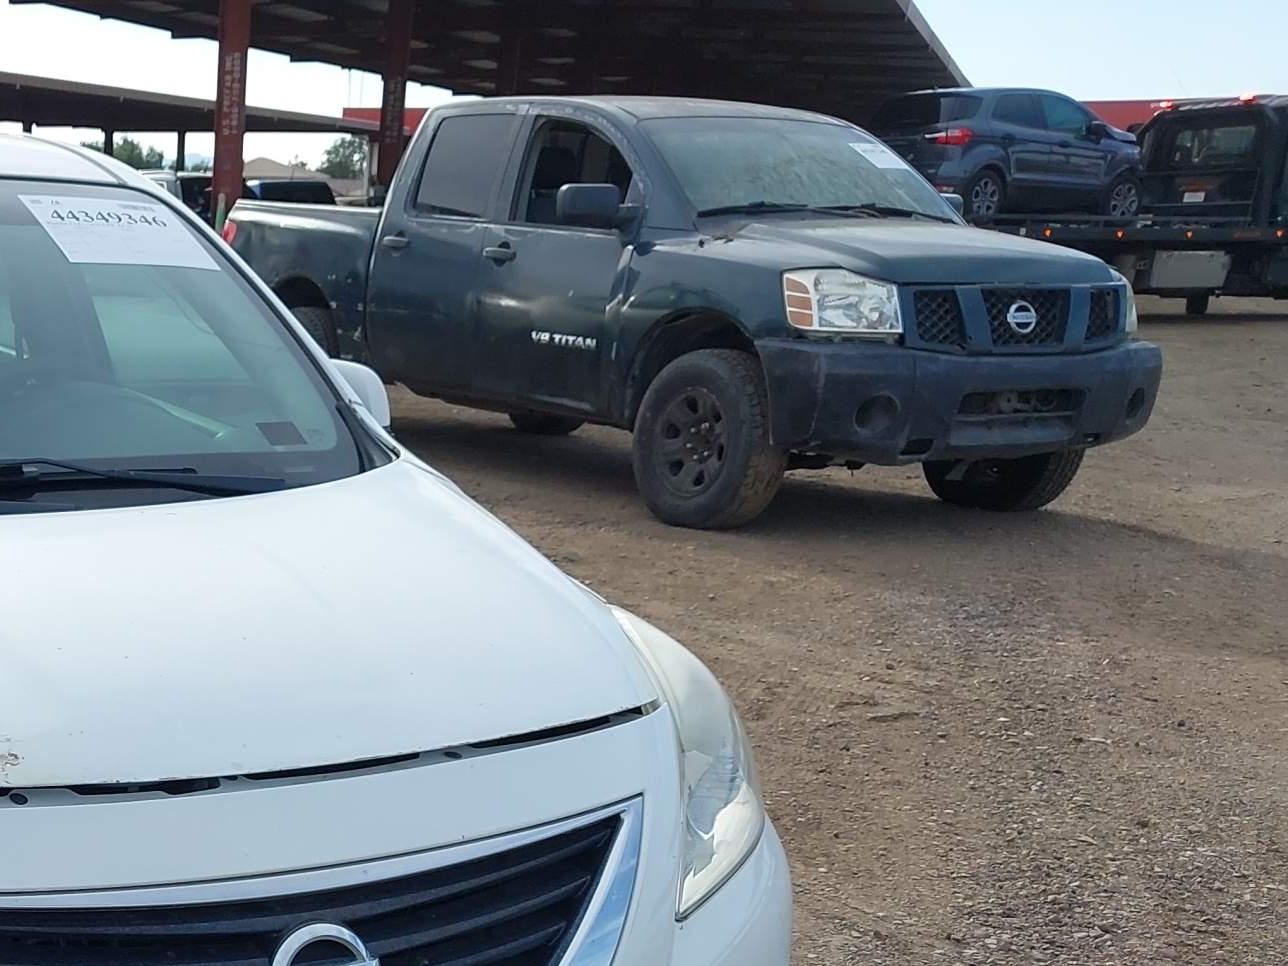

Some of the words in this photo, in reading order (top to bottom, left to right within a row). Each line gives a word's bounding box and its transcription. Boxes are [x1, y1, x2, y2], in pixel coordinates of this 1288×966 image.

[51, 209, 168, 228] 44349346
[531, 330, 551, 344] V8
[552, 333, 597, 349] TITAN
